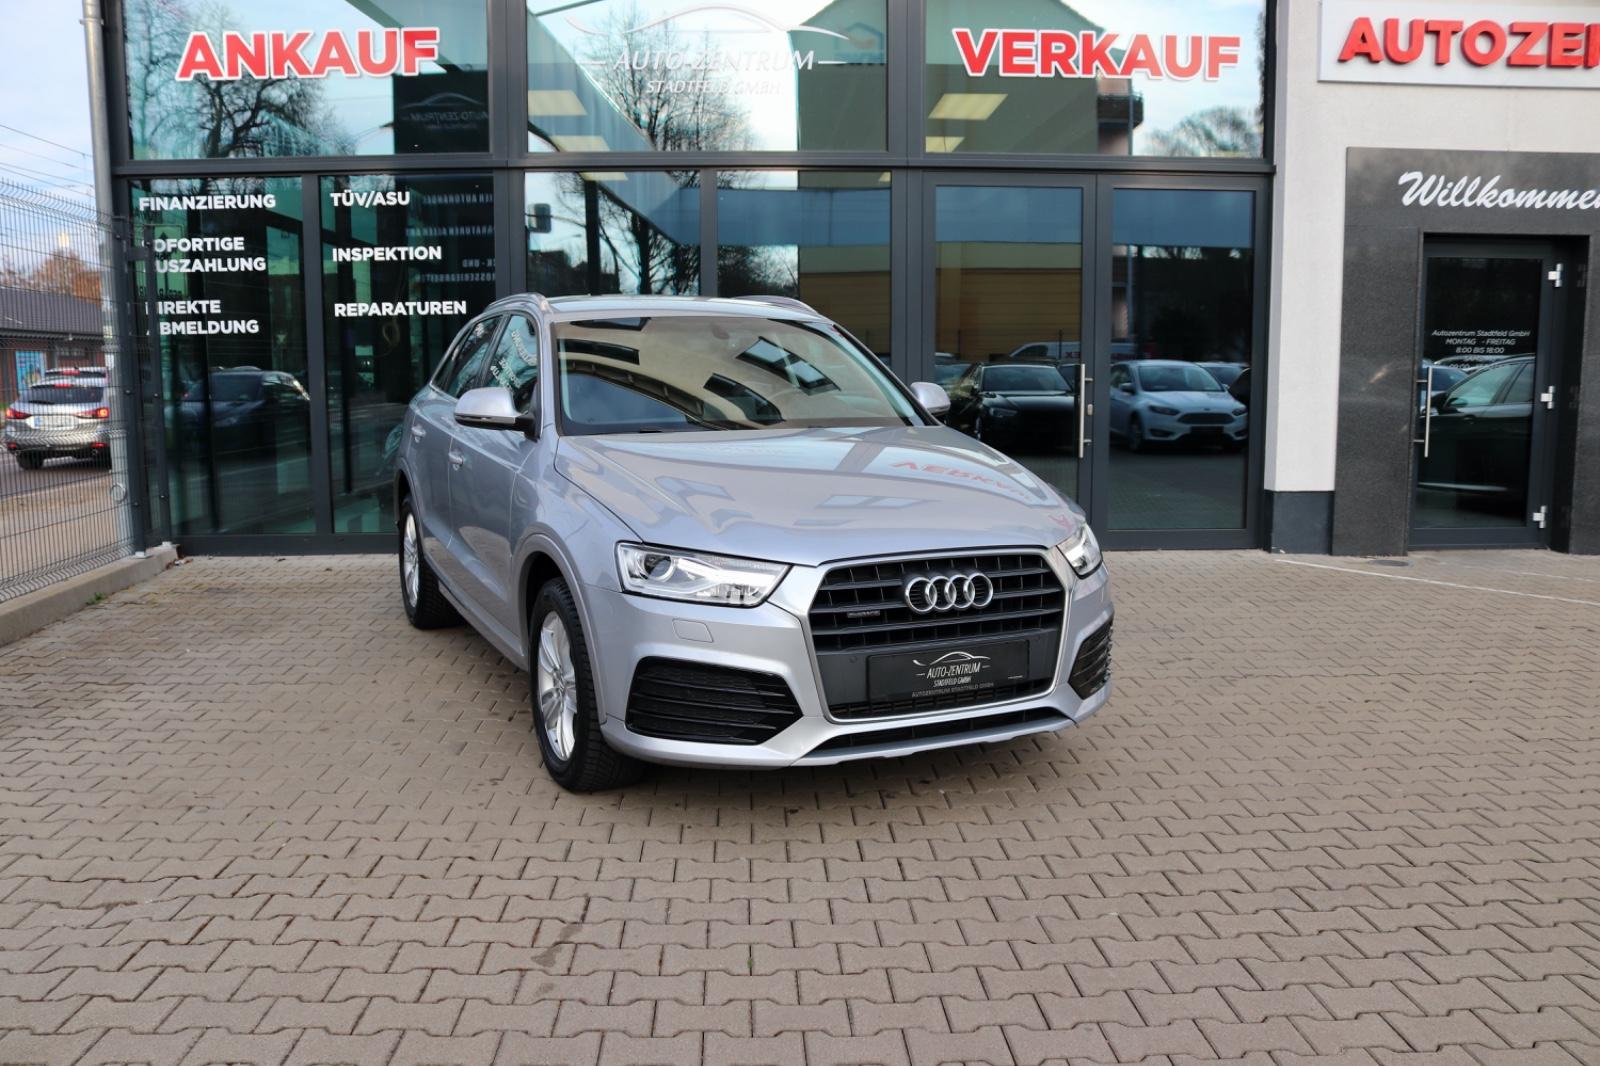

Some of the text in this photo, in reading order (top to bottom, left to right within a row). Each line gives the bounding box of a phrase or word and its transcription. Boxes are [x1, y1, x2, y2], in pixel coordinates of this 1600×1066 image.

[175, 28, 440, 81] ANKAUF
[613, 49, 814, 71] AUTO-ZENTRUM
[953, 28, 1241, 82] VERKAUF
[646, 80, 730, 94] STADTFELD
[139, 194, 276, 211] FINANZIERUNG
[330, 189, 411, 208] TÜV/ASU
[142, 237, 245, 252] OFORTIGE
[332, 246, 442, 262] INSPEKTION
[144, 257, 267, 273] USZAHLUNG
[145, 300, 221, 315] IREKTE
[334, 301, 467, 317] REPARATUREN
[146, 319, 260, 335] BMELDUNG
[926, 662, 981, 679] AUTO-ZENTRUM
